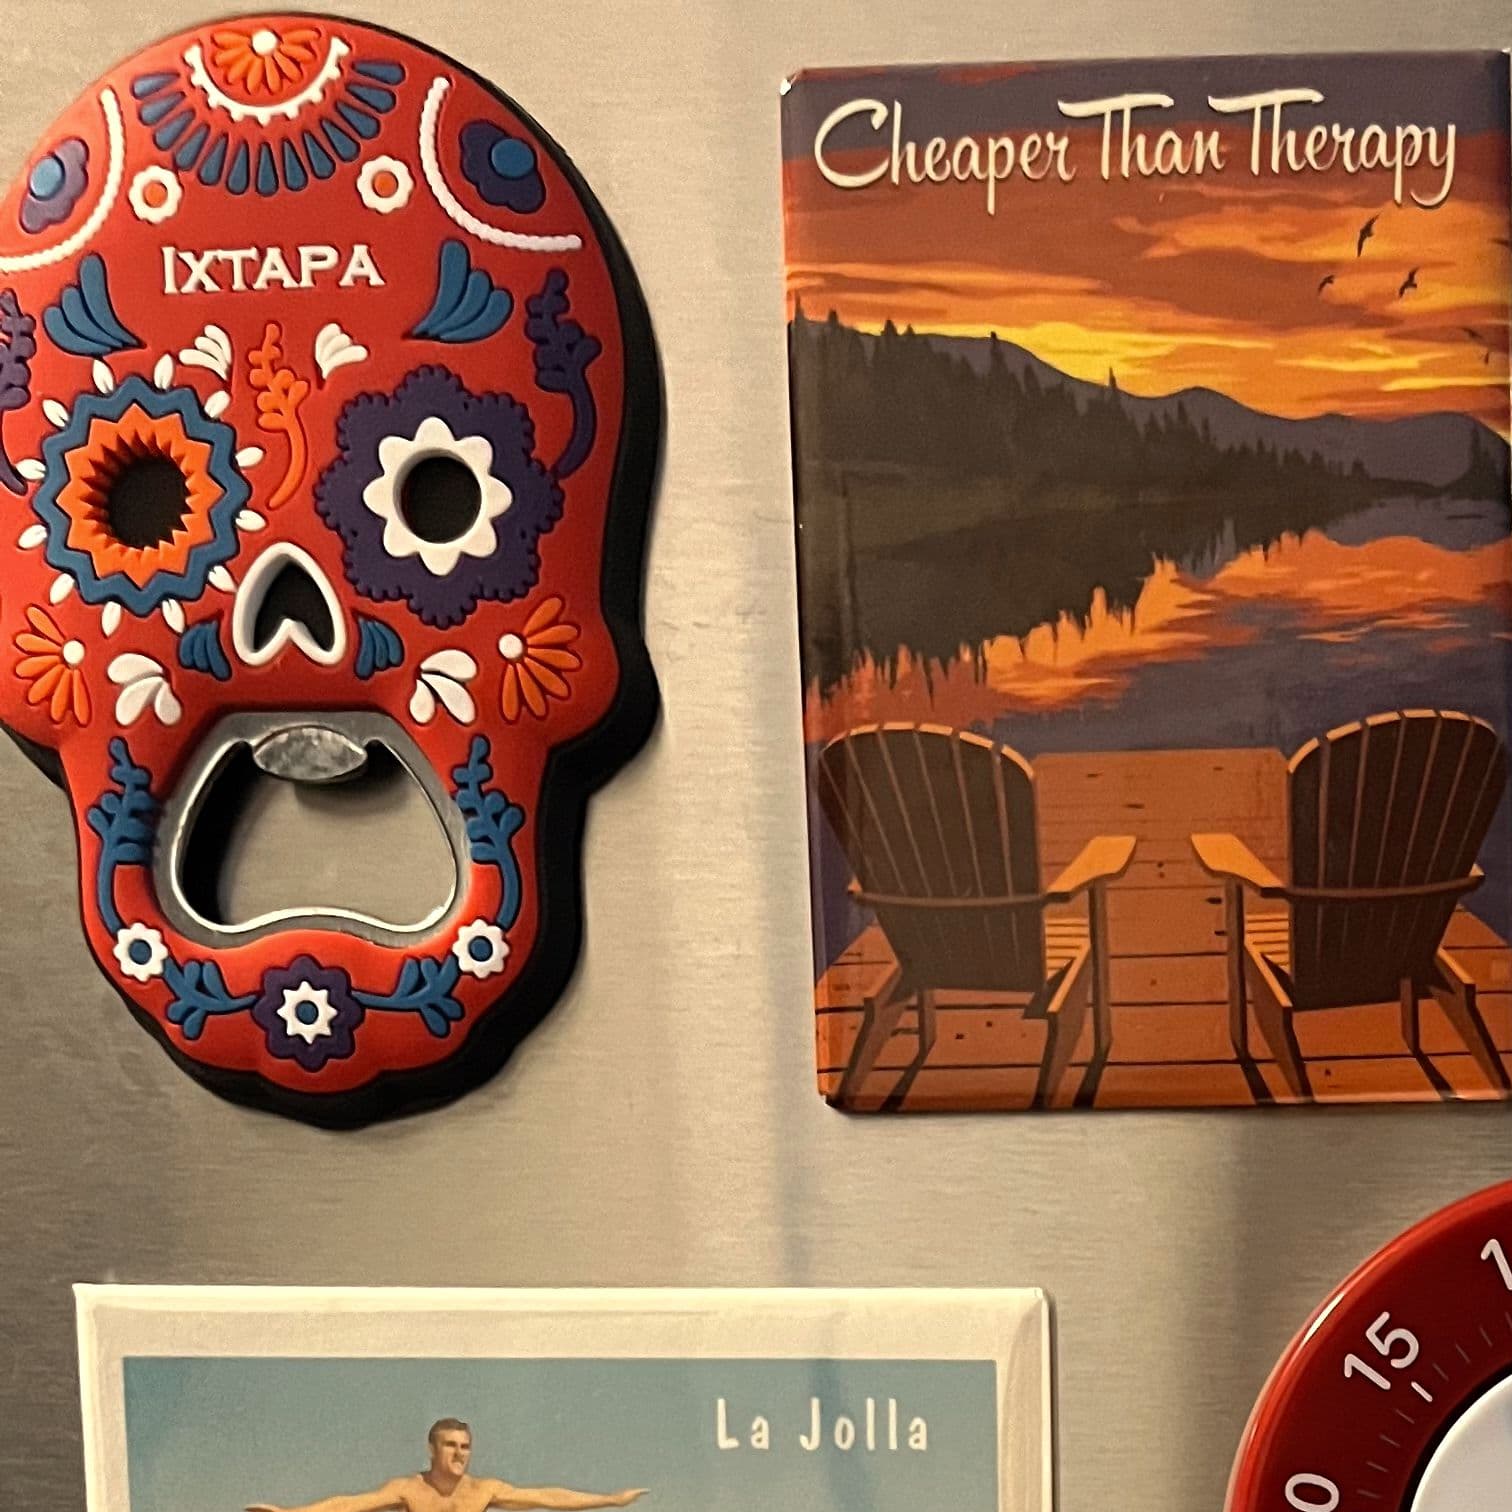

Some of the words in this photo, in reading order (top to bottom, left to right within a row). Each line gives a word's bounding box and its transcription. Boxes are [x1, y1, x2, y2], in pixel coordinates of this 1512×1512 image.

[814, 99, 1076, 215] Cheaper
[1057, 92, 1227, 180] Than
[1207, 88, 1458, 208] Therapy
[162, 243, 385, 295] IXTAPA
[1344, 1311, 1420, 1390] 15
[715, 1397, 770, 1451] La
[799, 1397, 929, 1453] Jolla
